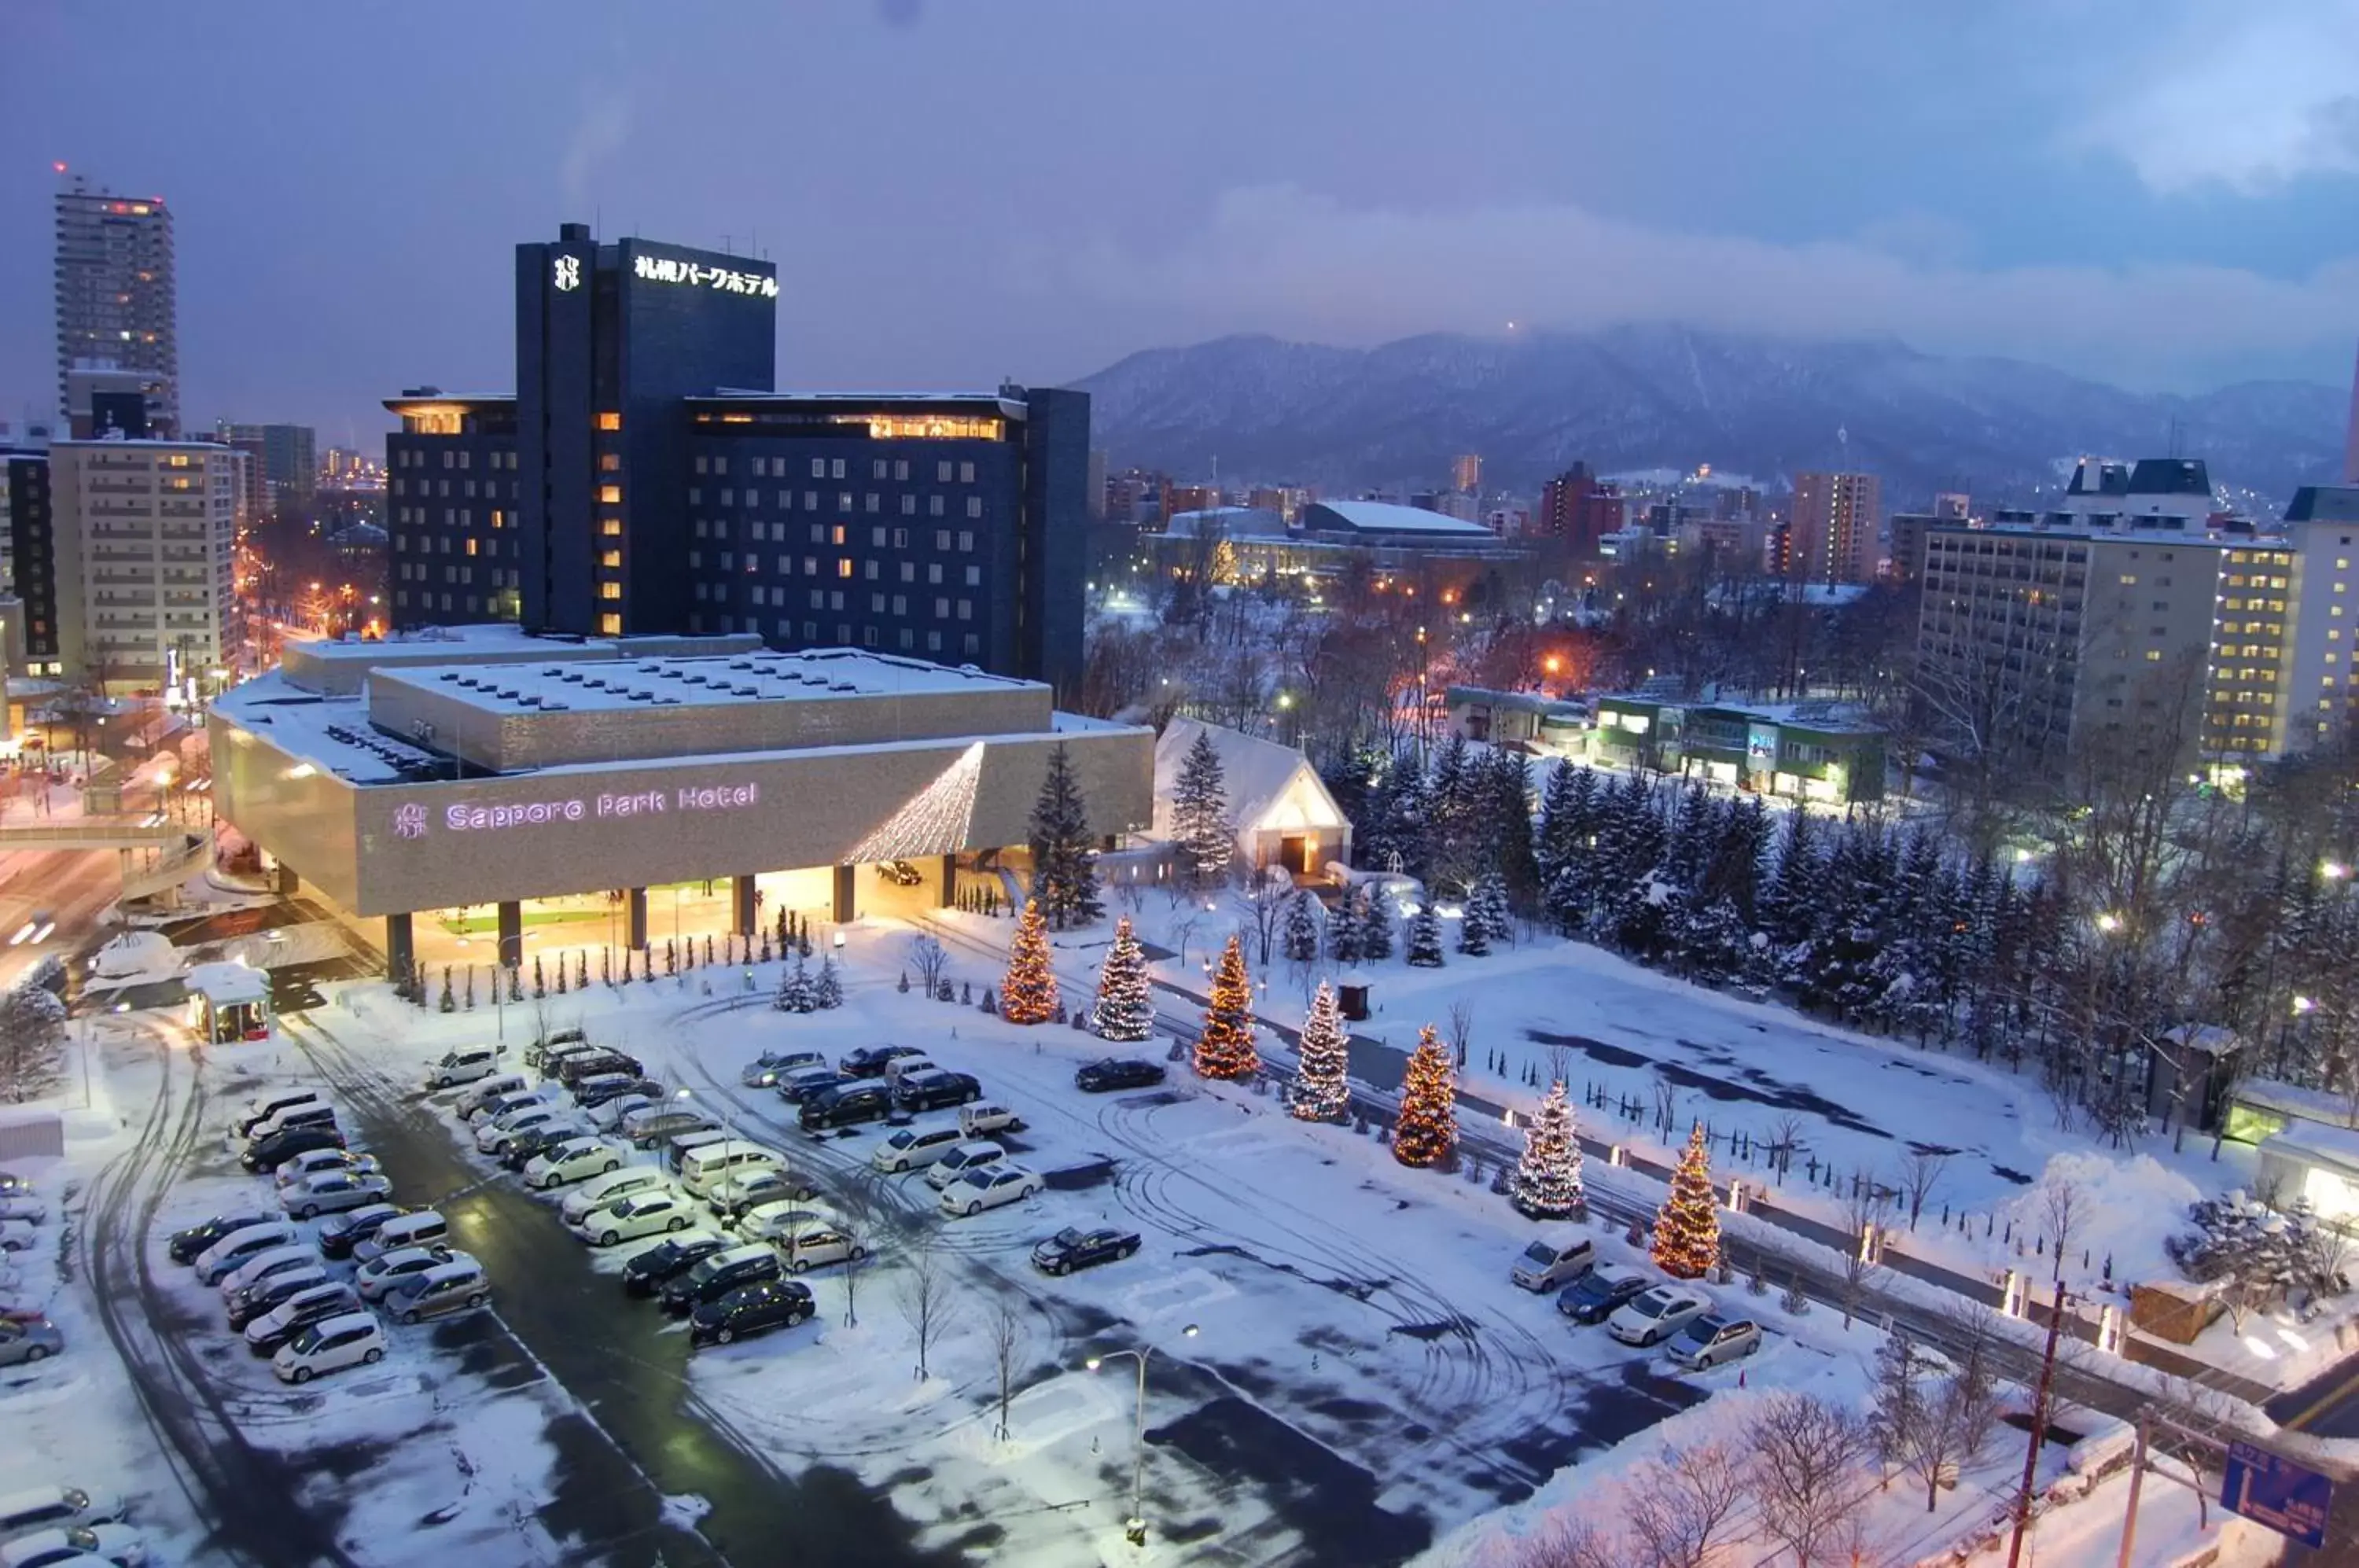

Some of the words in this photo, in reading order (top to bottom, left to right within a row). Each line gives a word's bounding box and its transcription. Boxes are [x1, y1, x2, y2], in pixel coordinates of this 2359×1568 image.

[446, 800, 585, 830] Sapporo
[597, 790, 666, 818] Park
[679, 782, 757, 808] Hotel
